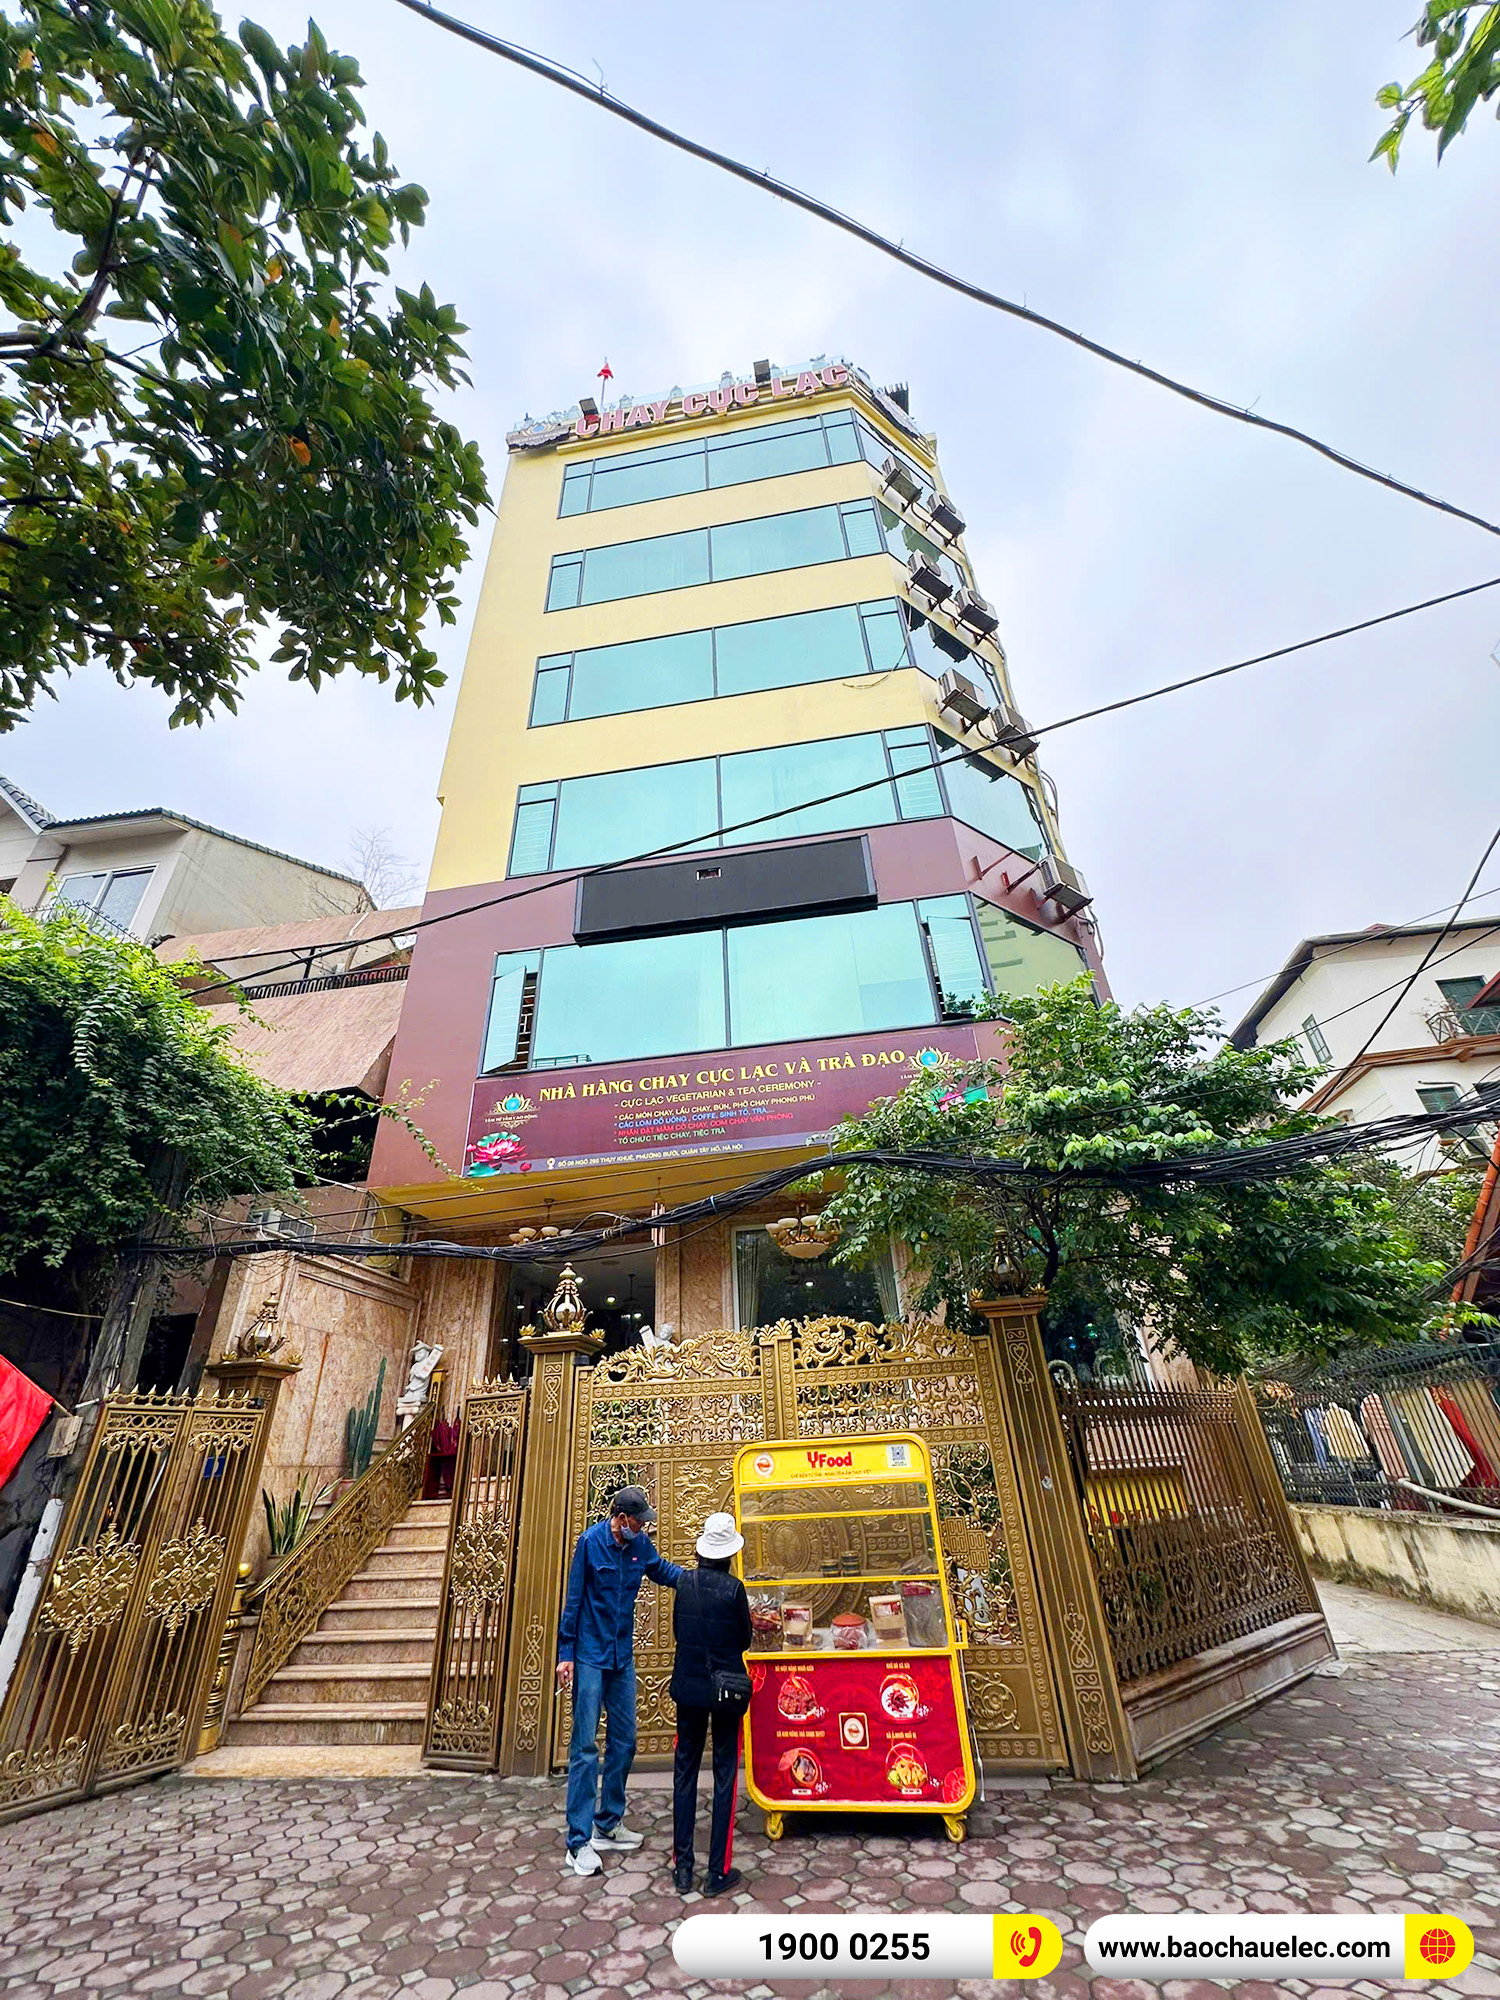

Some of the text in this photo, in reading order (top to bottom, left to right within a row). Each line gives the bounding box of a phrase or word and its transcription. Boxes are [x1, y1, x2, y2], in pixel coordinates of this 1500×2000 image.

[575, 400, 670, 436] CHAY
[771, 365, 848, 397] LẠC
[539, 1050, 906, 1101] NHÀ HÀNG CHAY CỰC LẠC VÀ TRÀ ĐẠO
[620, 1080, 814, 1108] CỰC LẠC VEGETARIAN & TEA CEREMONY
[618, 1120, 634, 1129] CÁC
[719, 1110, 737, 1118] SINH
[619, 1113, 634, 1121] CÁC
[750, 1099, 769, 1107] CHAY
[771, 1096, 798, 1105] PHONG
[807, 1451, 853, 1469] YFood
